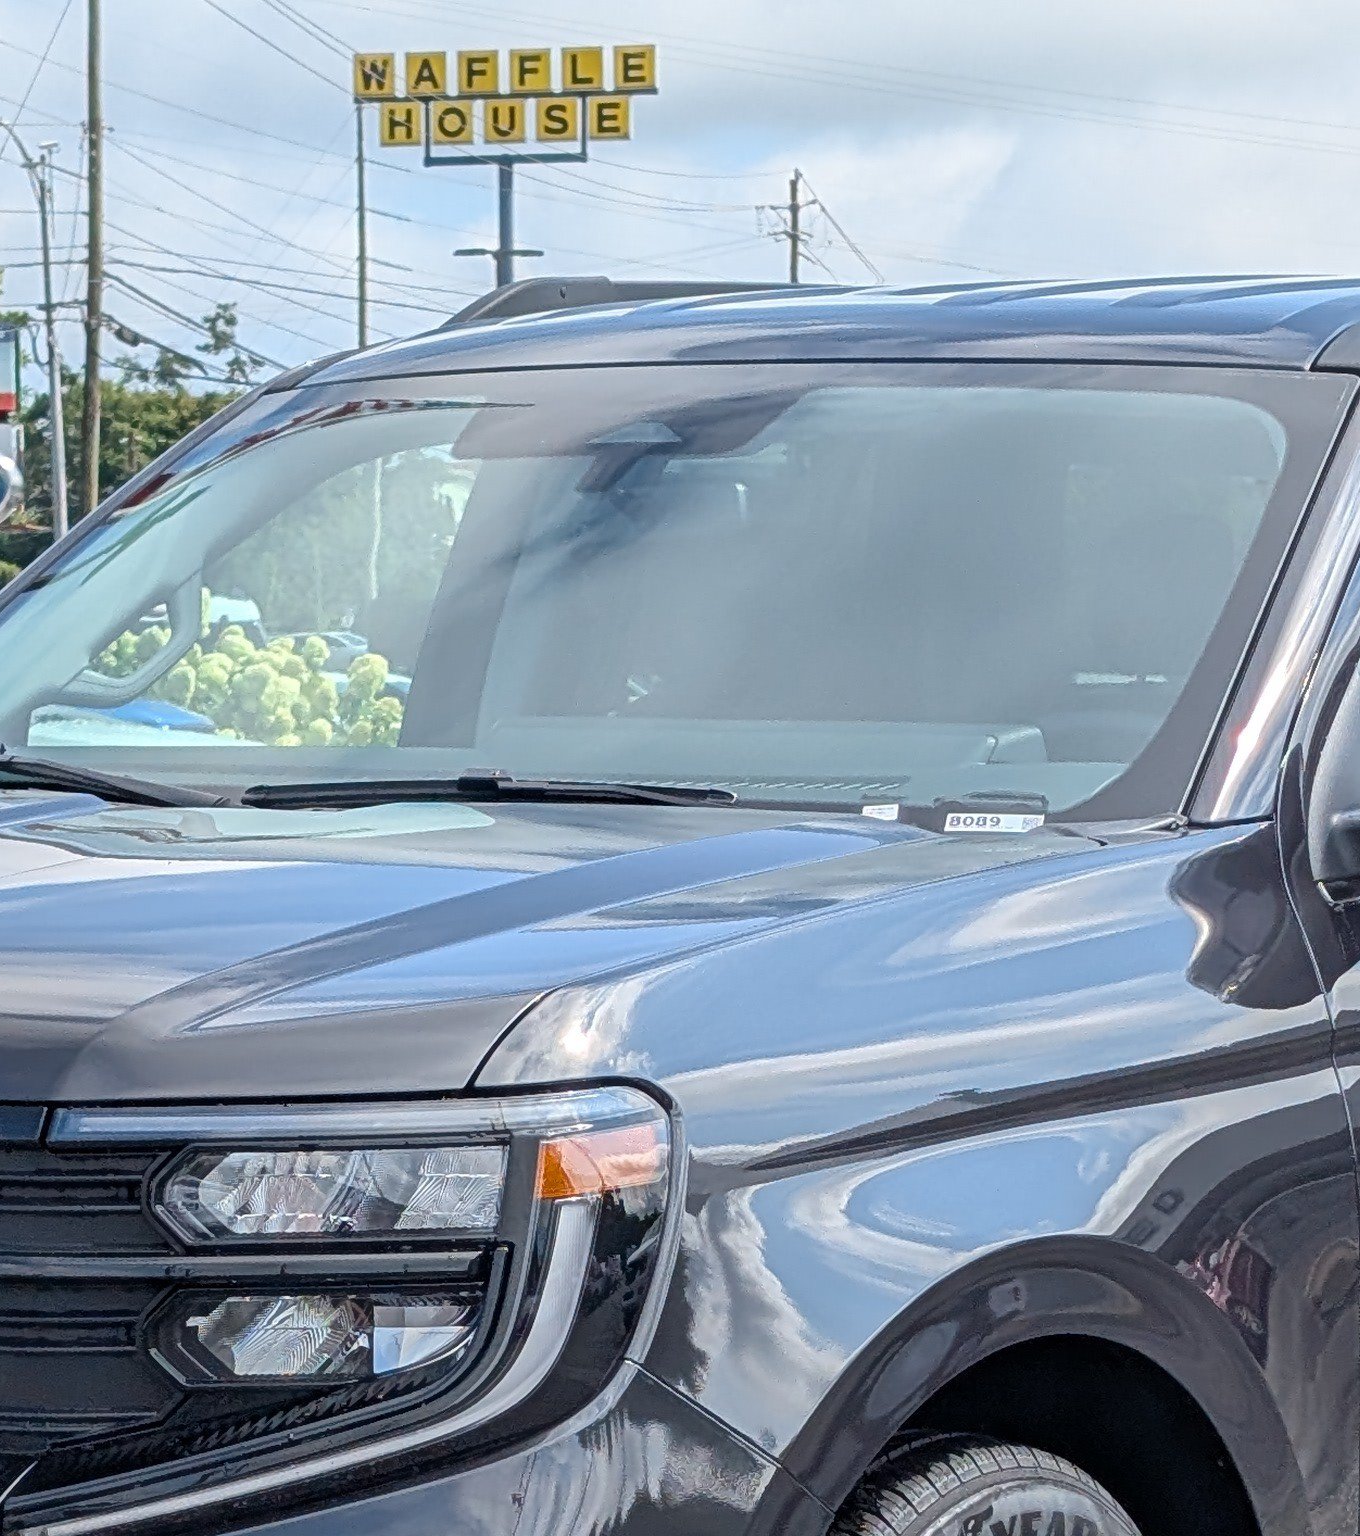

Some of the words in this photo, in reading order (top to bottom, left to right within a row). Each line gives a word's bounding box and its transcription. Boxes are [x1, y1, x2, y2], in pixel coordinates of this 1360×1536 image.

[360, 52, 647, 91] WAFFLE
[388, 102, 621, 139] HOUSE
[948, 815, 1001, 827] 8089
